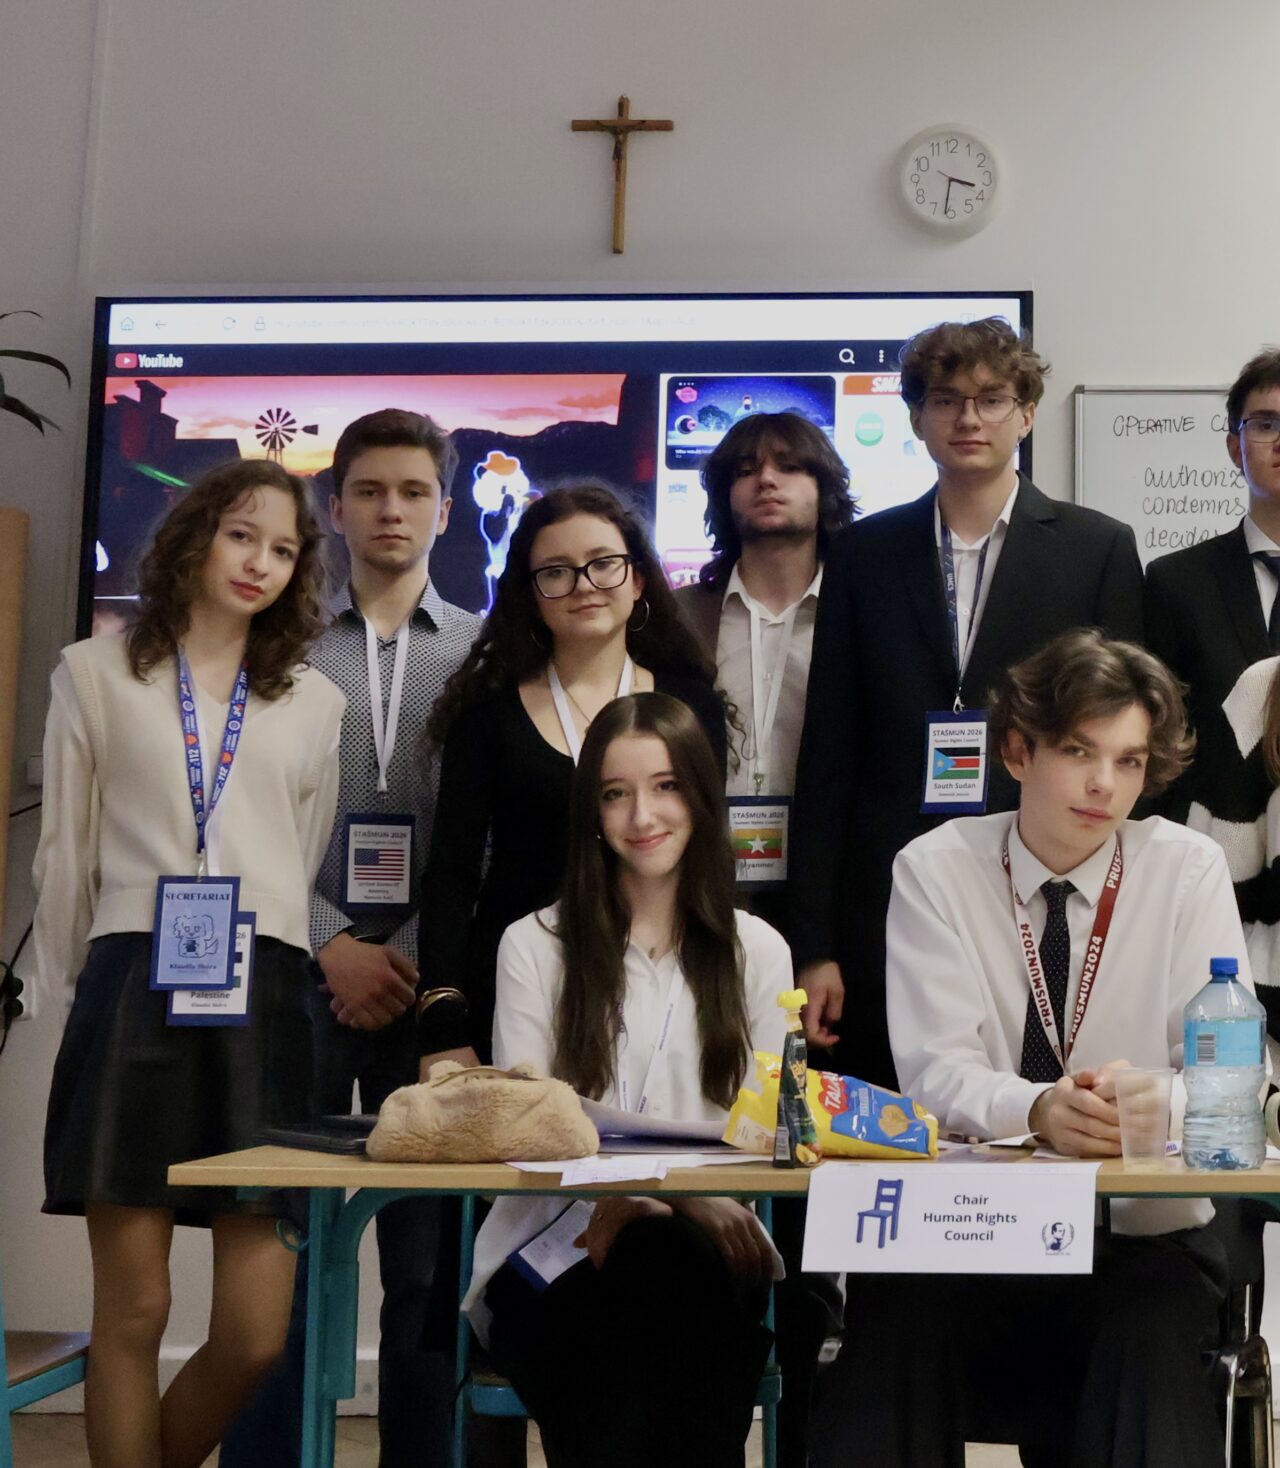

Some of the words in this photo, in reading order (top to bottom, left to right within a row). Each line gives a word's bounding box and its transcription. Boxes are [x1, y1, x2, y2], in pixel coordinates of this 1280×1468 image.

[930, 142, 940, 156] 11
[944, 138, 959, 153] 12
[914, 156, 930, 172] 10
[976, 153, 986, 168] 2
[910, 174, 920, 188] 9
[982, 170, 992, 186] 3
[915, 188, 925, 204] 8
[975, 189, 984, 201] 4
[929, 202, 938, 216] 7
[945, 204, 956, 219] 6
[963, 199, 974, 214] 5
[138, 353, 184, 370] YouTube
[1112, 414, 1195, 437] OPERATIVE
[1143, 463, 1246, 489] authoriz
[1142, 496, 1246, 517] condemns
[1144, 526, 1219, 549] decide
[188, 748, 200, 763] 112
[217, 766, 228, 781] 112
[165, 892, 231, 901] SECRETARIAT
[1020, 923, 1053, 1028] PRUSMUN2024
[190, 991, 231, 999] Palestine
[953, 1194, 989, 1206] Chair
[923, 1212, 972, 1223] Human
[976, 1212, 1017, 1226] Rights
[944, 1230, 994, 1242] Council
